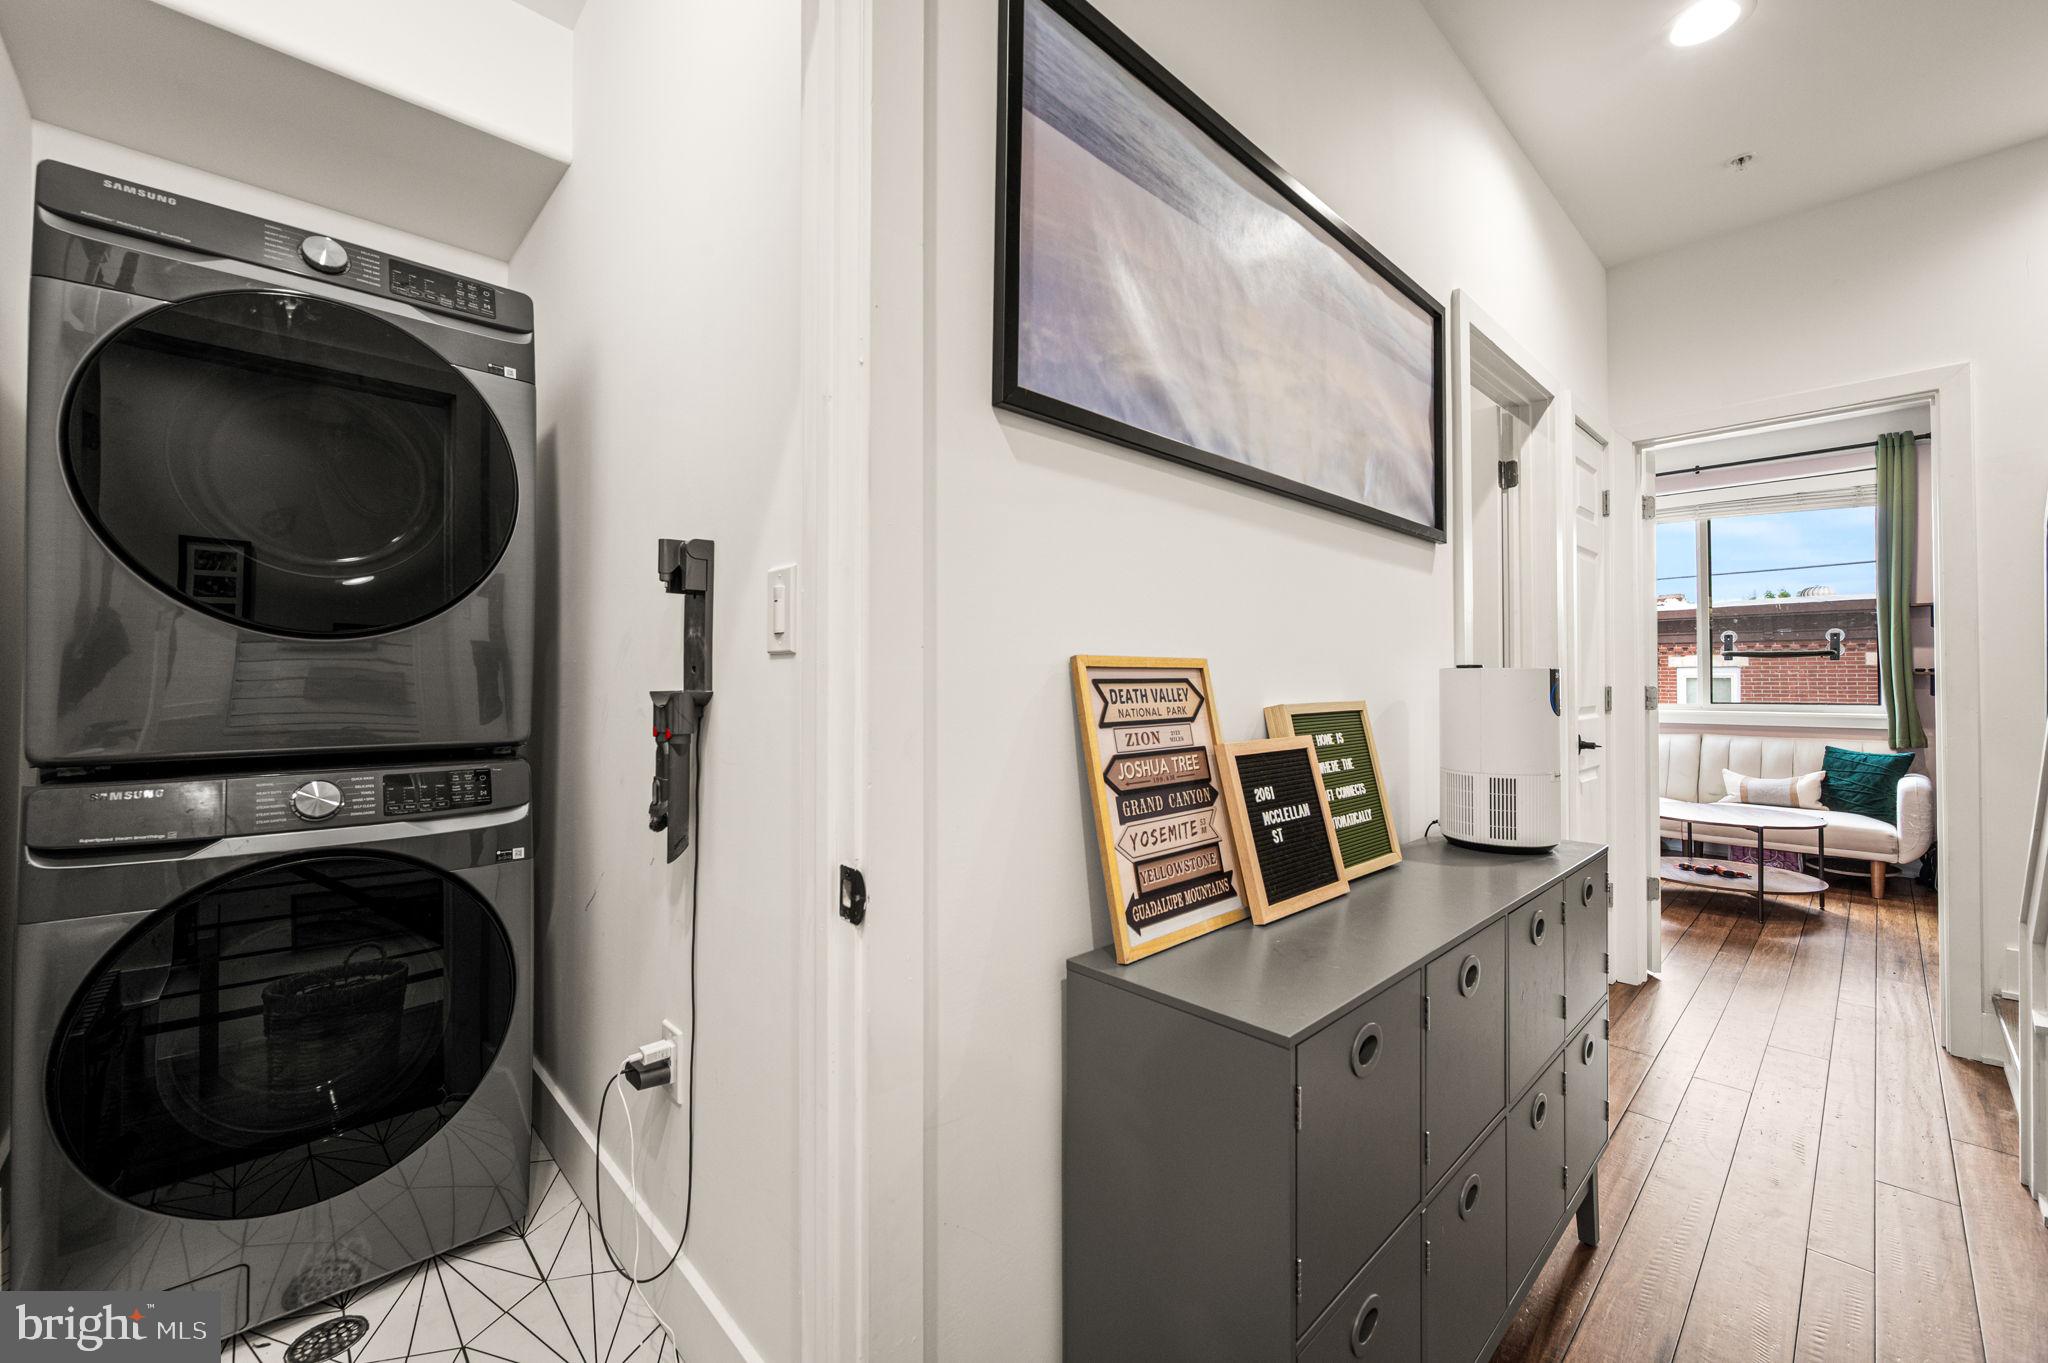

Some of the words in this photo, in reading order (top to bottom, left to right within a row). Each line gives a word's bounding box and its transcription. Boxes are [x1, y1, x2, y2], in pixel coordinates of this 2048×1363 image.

[103, 180, 177, 206] SAMSUNG
[1109, 688, 1148, 704] DEATH
[1150, 687, 1188, 703] VALLEY
[1118, 707, 1162, 718] NATIONAL
[1166, 706, 1188, 716] PARK
[1125, 731, 1160, 747] ZION
[1315, 733, 1335, 746] HOME
[1335, 732, 1344, 744] IS
[1118, 758, 1170, 780] JOSHUA
[1171, 754, 1200, 773] TREE
[1341, 757, 1355, 771] THE
[90, 789, 164, 801] SAMSUNG
[1254, 786, 1276, 803] 2061
[1335, 783, 1367, 800] CONNECTS
[1122, 795, 1164, 817] GRAND
[1168, 787, 1211, 808] CANYON
[1262, 803, 1311, 826] MCCLELLAN
[1332, 808, 1372, 829] TOMATICALLY
[1130, 820, 1198, 851] YOSEMITE
[1271, 827, 1284, 844] ST
[1140, 852, 1217, 886] YELLOWSTONE
[1132, 892, 1185, 922] GUADALUPE
[1183, 878, 1230, 906] MOUNTAINS
